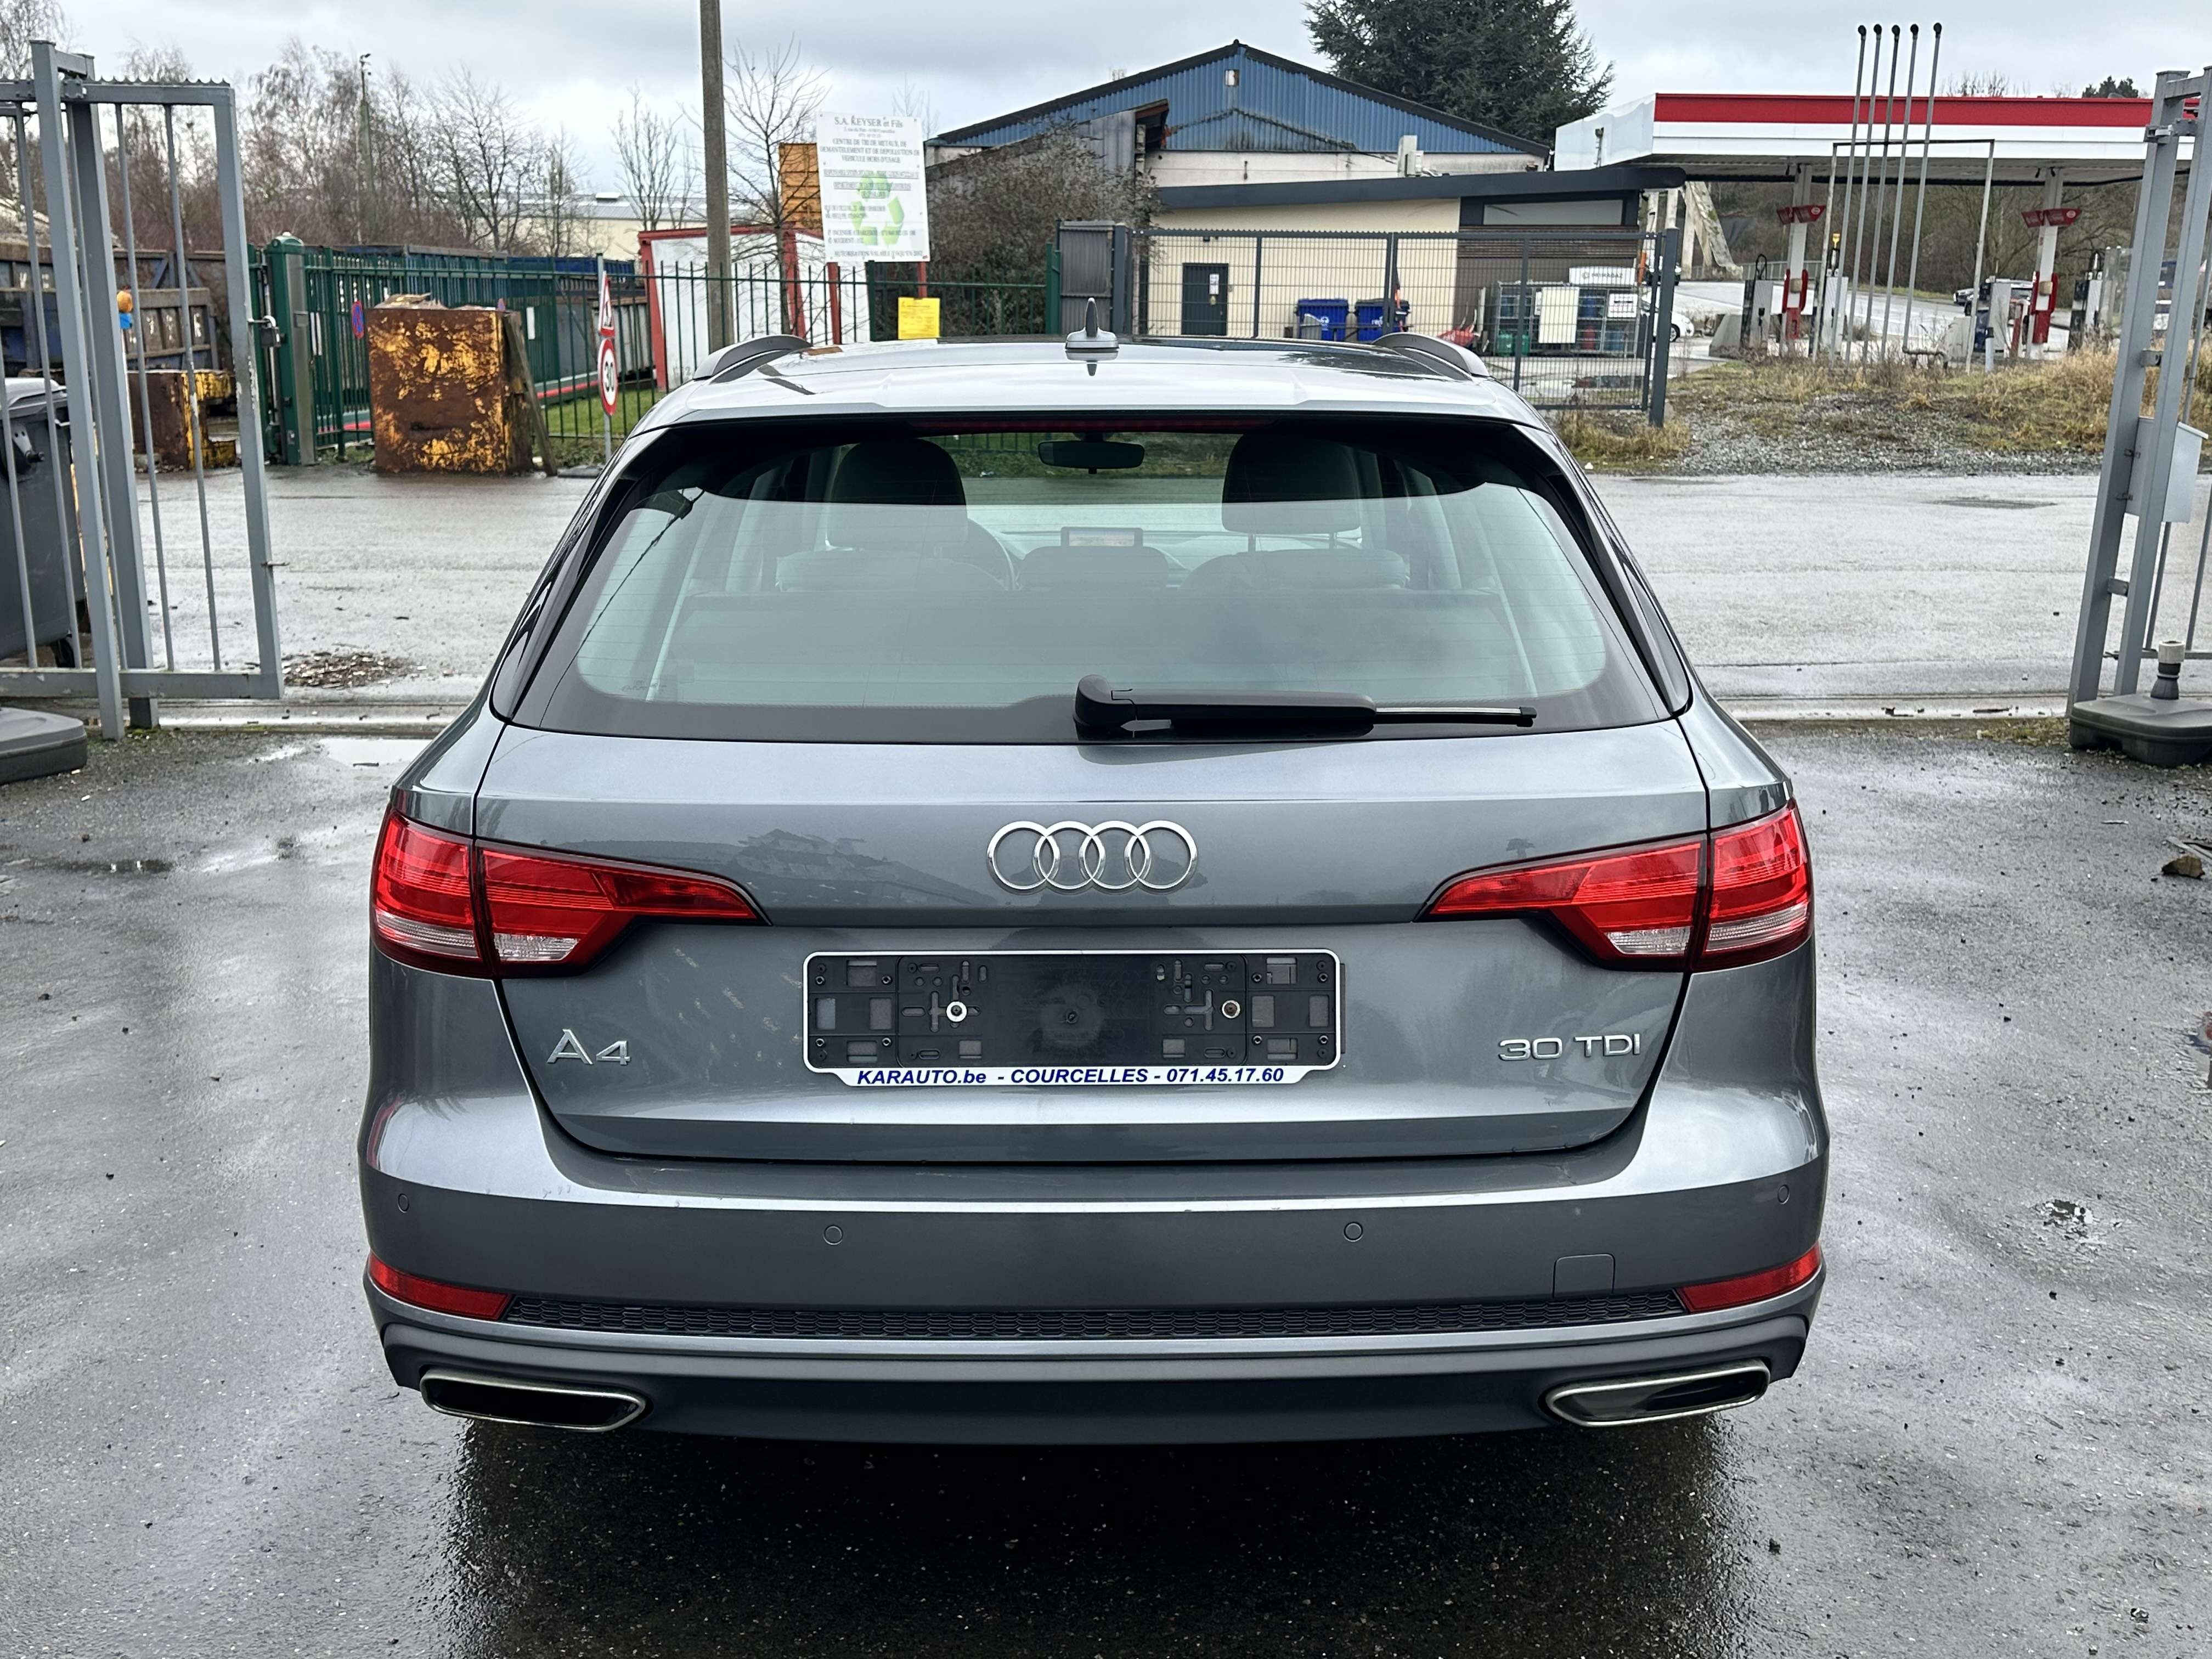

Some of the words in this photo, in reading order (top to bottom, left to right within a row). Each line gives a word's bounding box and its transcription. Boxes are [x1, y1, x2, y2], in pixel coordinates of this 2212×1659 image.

[851, 117, 882, 127] KEYSER
[605, 360, 614, 392] 30
[546, 1028, 631, 1065] A4
[1499, 1037, 1562, 1060] 30
[1573, 1034, 1640, 1057] TDI
[857, 1070, 986, 1085] KARAUTO.be
[1011, 1069, 1148, 1084] COURCELLES
[1166, 1068, 1284, 1082] 071.45.17.60
